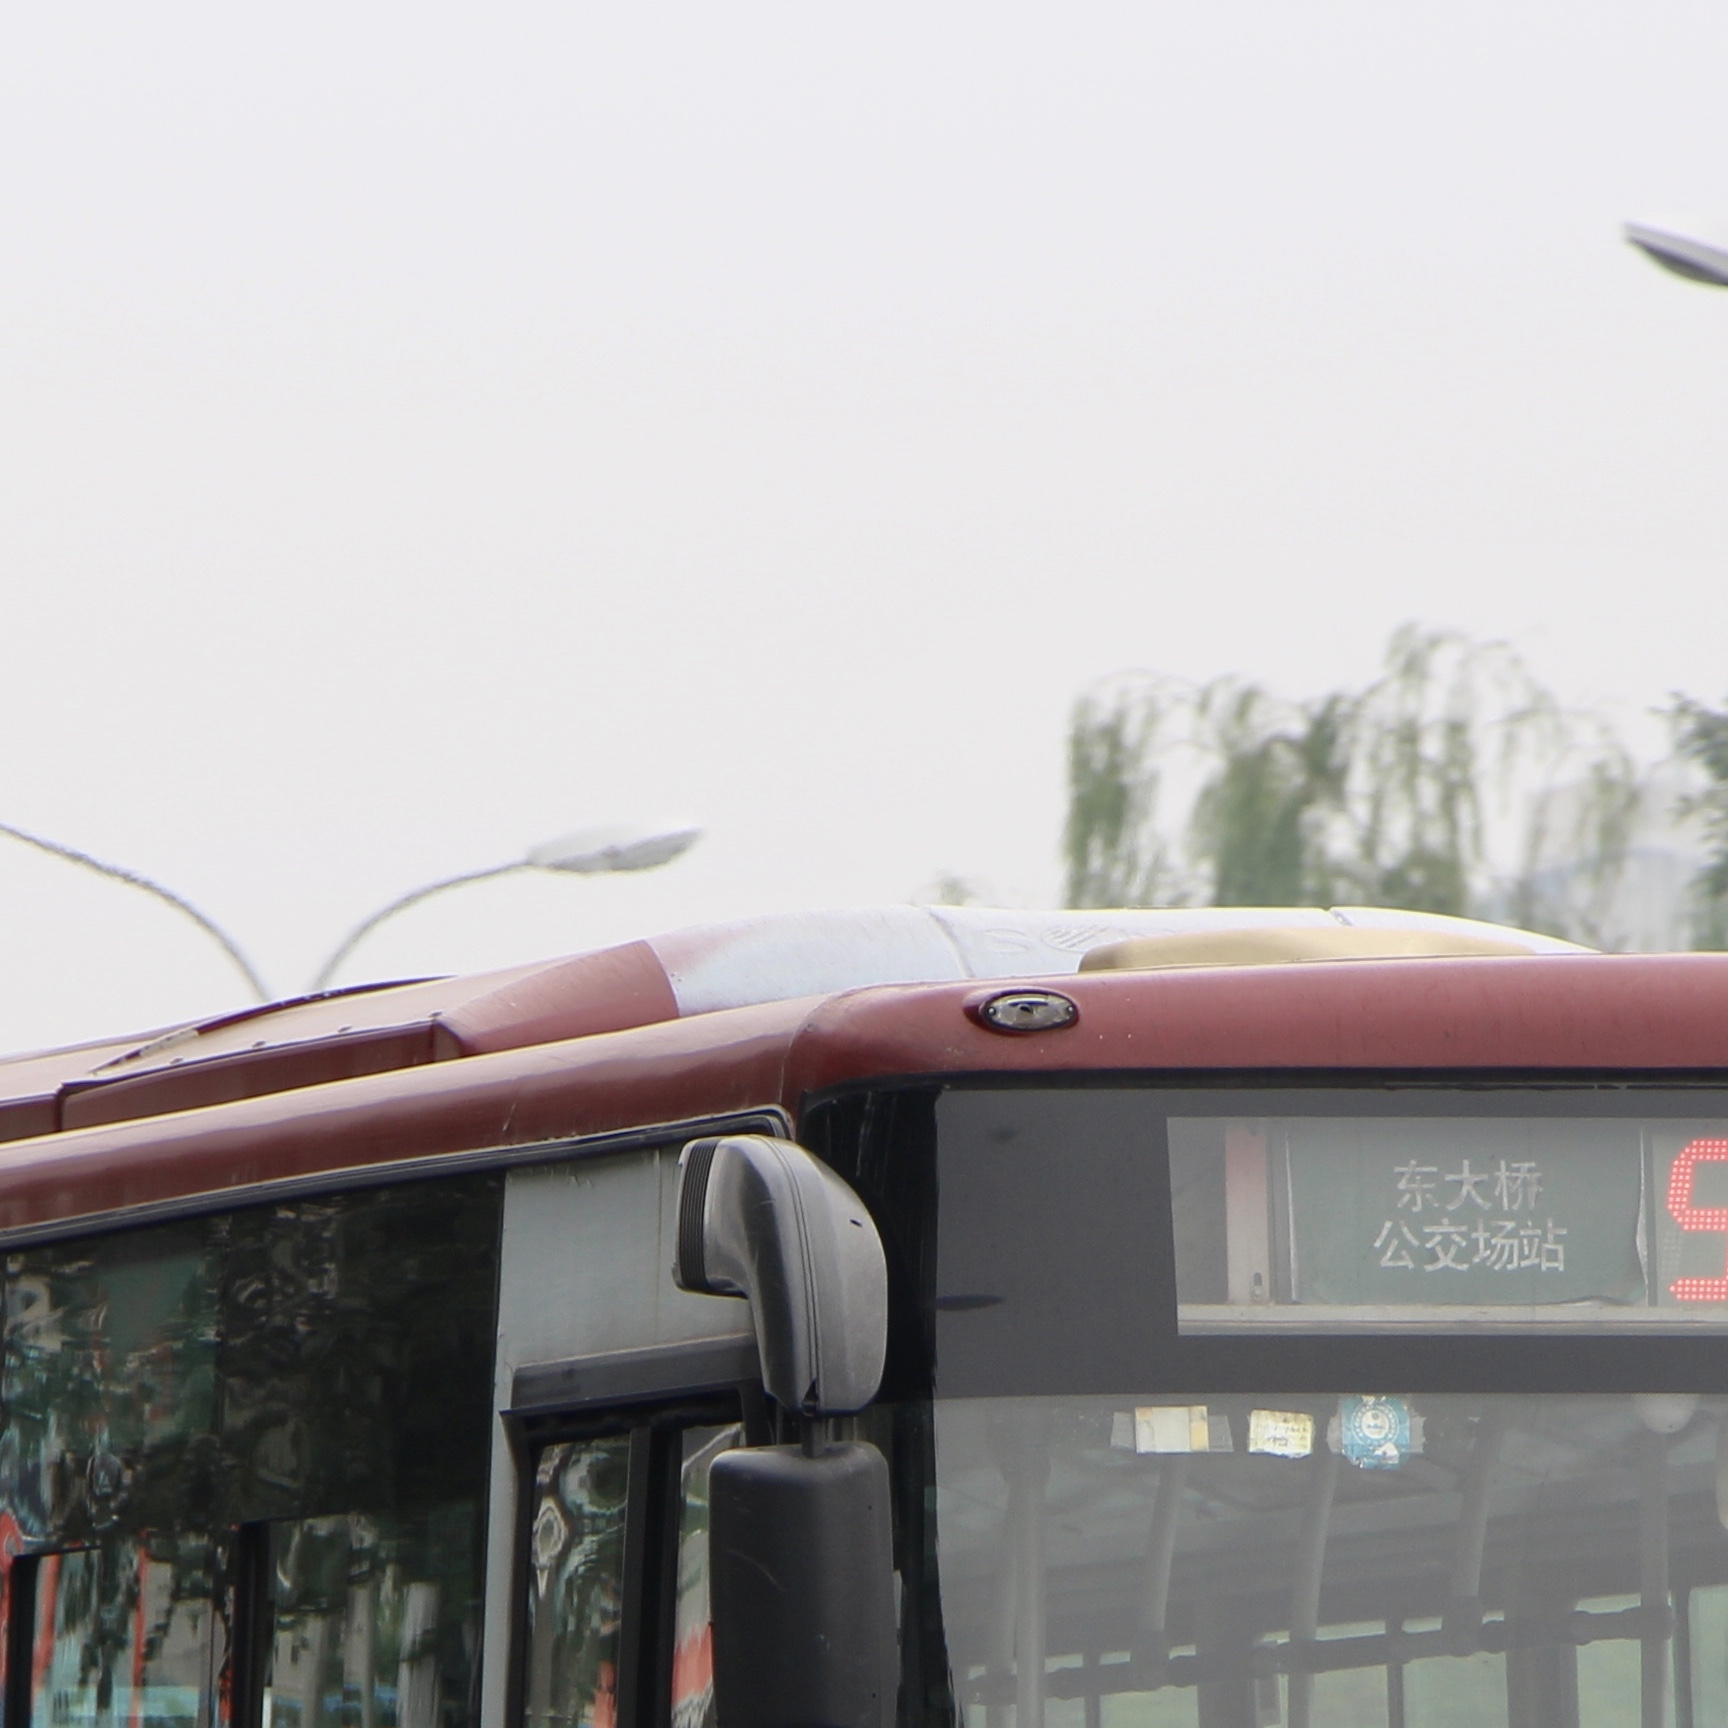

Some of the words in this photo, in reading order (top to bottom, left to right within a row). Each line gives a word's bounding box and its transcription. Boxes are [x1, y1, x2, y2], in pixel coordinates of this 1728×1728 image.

[1393, 1159, 1543, 1212] 东大桥
[1373, 1218, 1568, 1272] 公交场站
